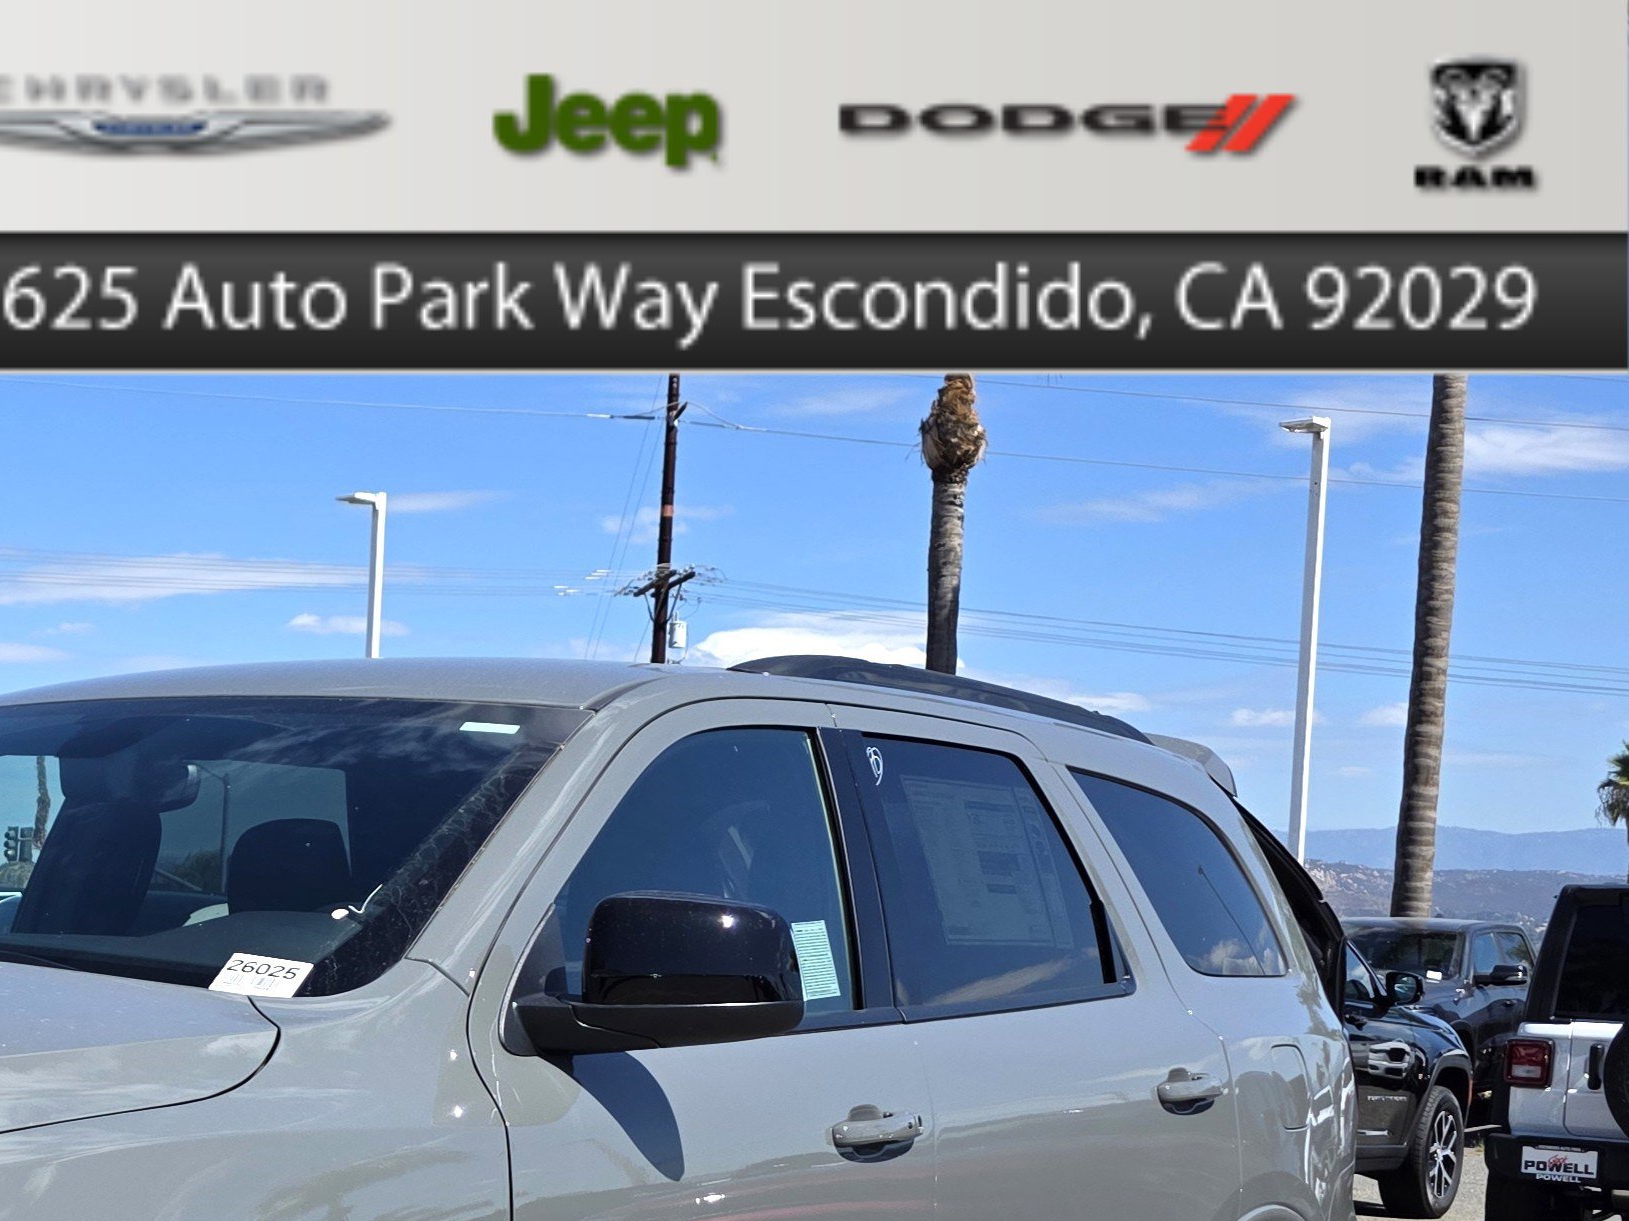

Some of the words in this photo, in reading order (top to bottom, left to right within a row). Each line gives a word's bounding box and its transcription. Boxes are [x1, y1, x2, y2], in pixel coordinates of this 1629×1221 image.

[226, 959, 300, 980] 26025
[1524, 1160, 1594, 1175] POWELL
[1536, 1174, 1581, 1183] POWELL
